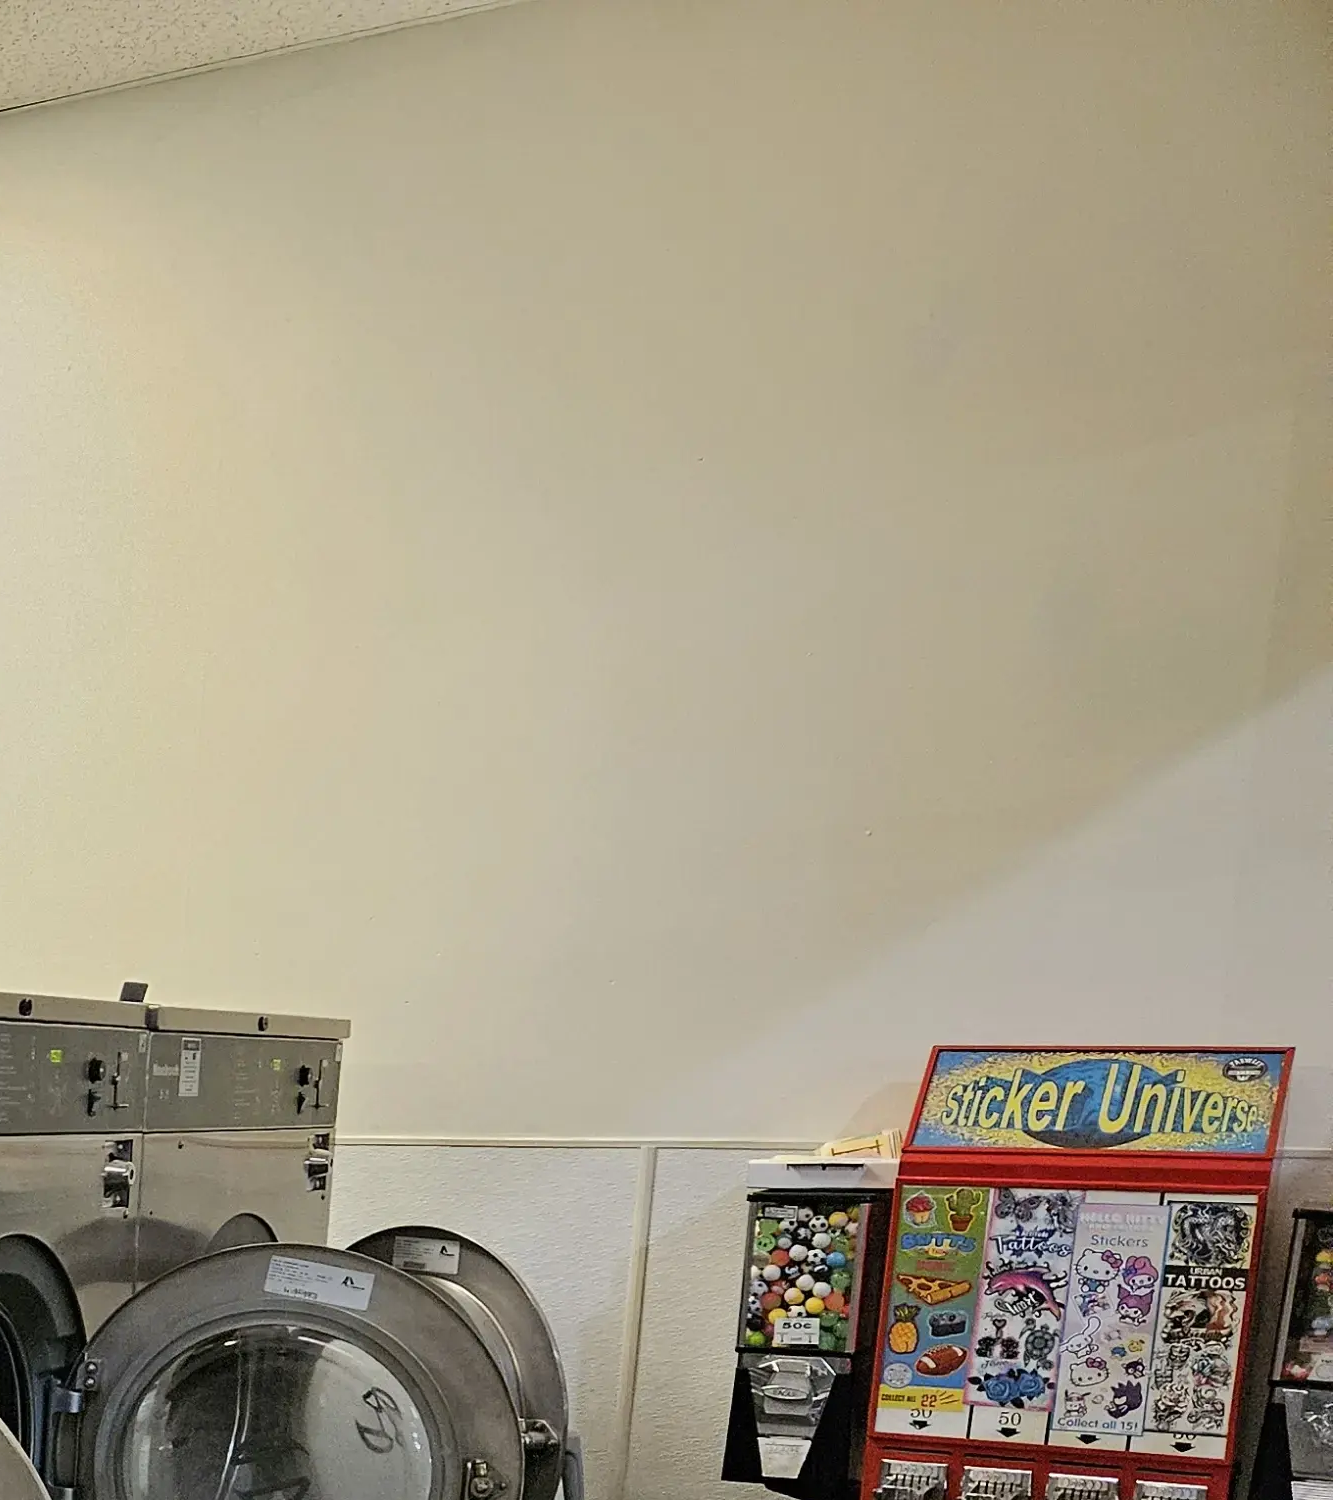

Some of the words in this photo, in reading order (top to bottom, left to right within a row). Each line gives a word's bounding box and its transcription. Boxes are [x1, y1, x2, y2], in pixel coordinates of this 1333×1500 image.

[1098, 1062, 1259, 1135] Universe
[989, 1234, 1074, 1257] Tattoos
[1090, 1234, 1149, 1248] Stickers
[1189, 1266, 1223, 1276] URBAN
[1165, 1273, 1246, 1290] TATTOOS
[920, 1393, 938, 1408] 22
[998, 1411, 1022, 1426] 50
[1057, 1416, 1099, 1428] Collect
[1102, 1419, 1117, 1429] all
